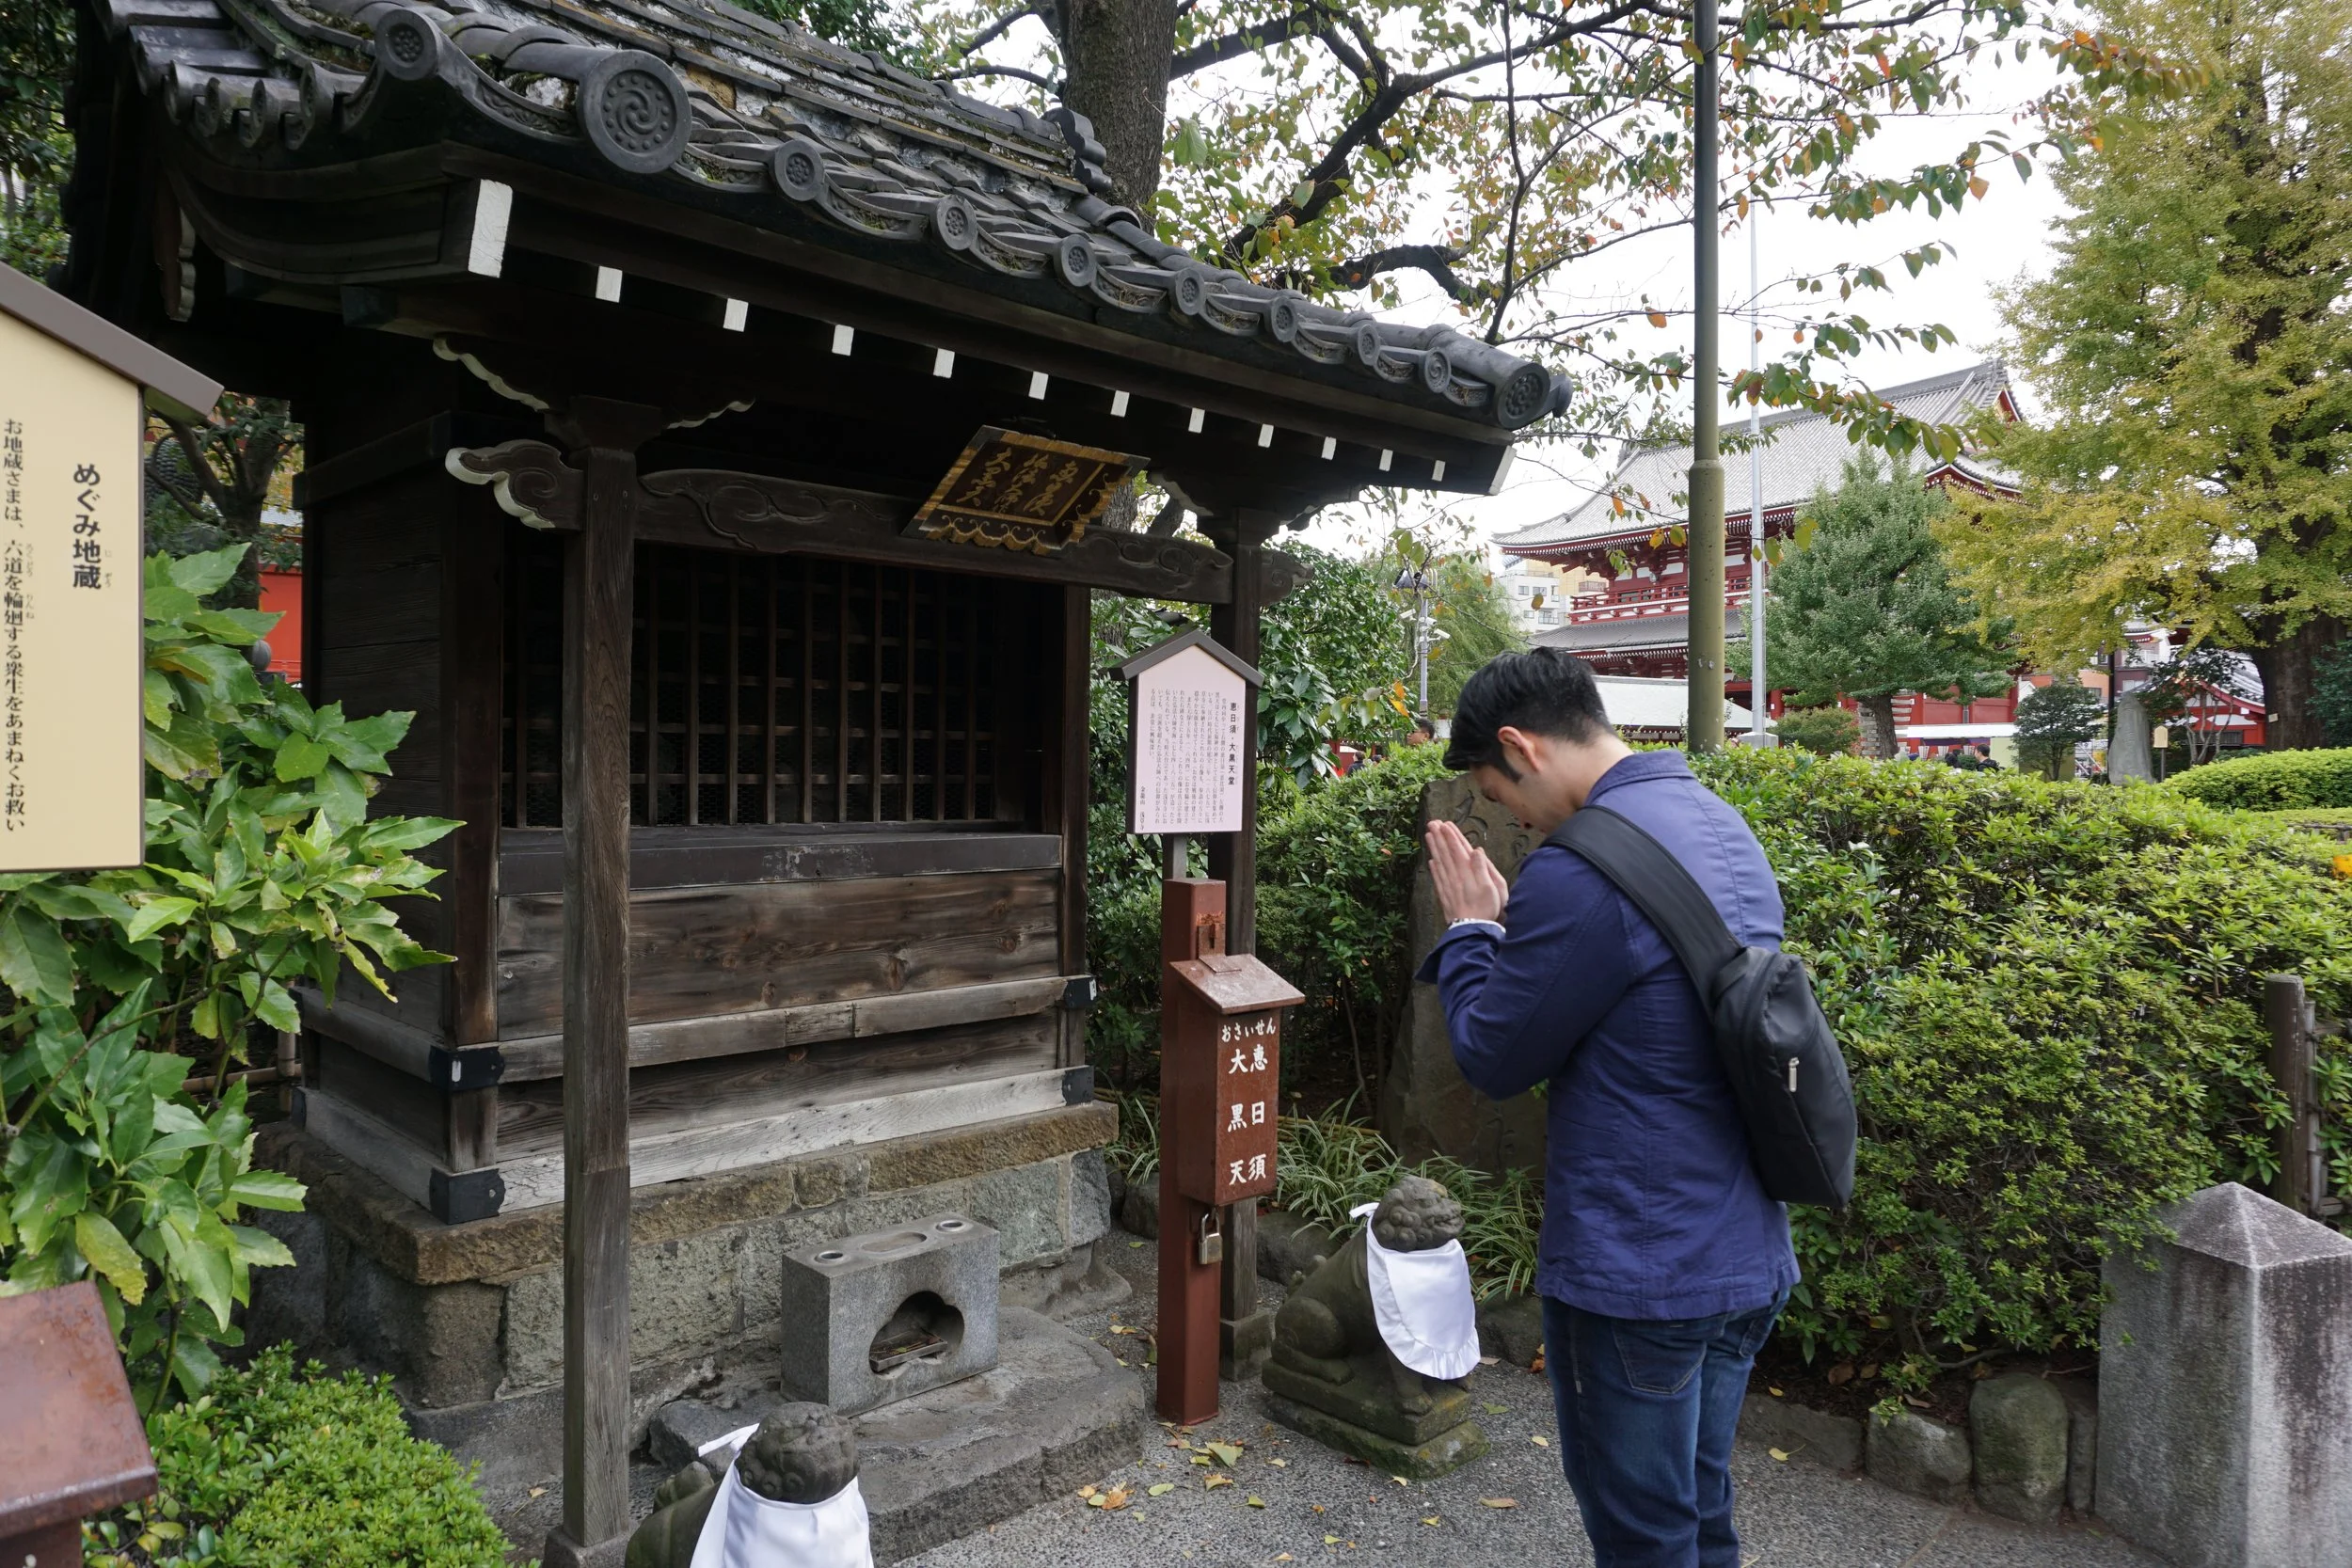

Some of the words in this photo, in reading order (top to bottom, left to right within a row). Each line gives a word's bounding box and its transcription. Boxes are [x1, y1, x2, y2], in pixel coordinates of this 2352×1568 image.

[73, 464, 102, 590] めぐみ地蔵
[1228, 703, 1237, 784] 恵日須・大黒天堂
[1222, 1017, 1276, 1042] おさいせん
